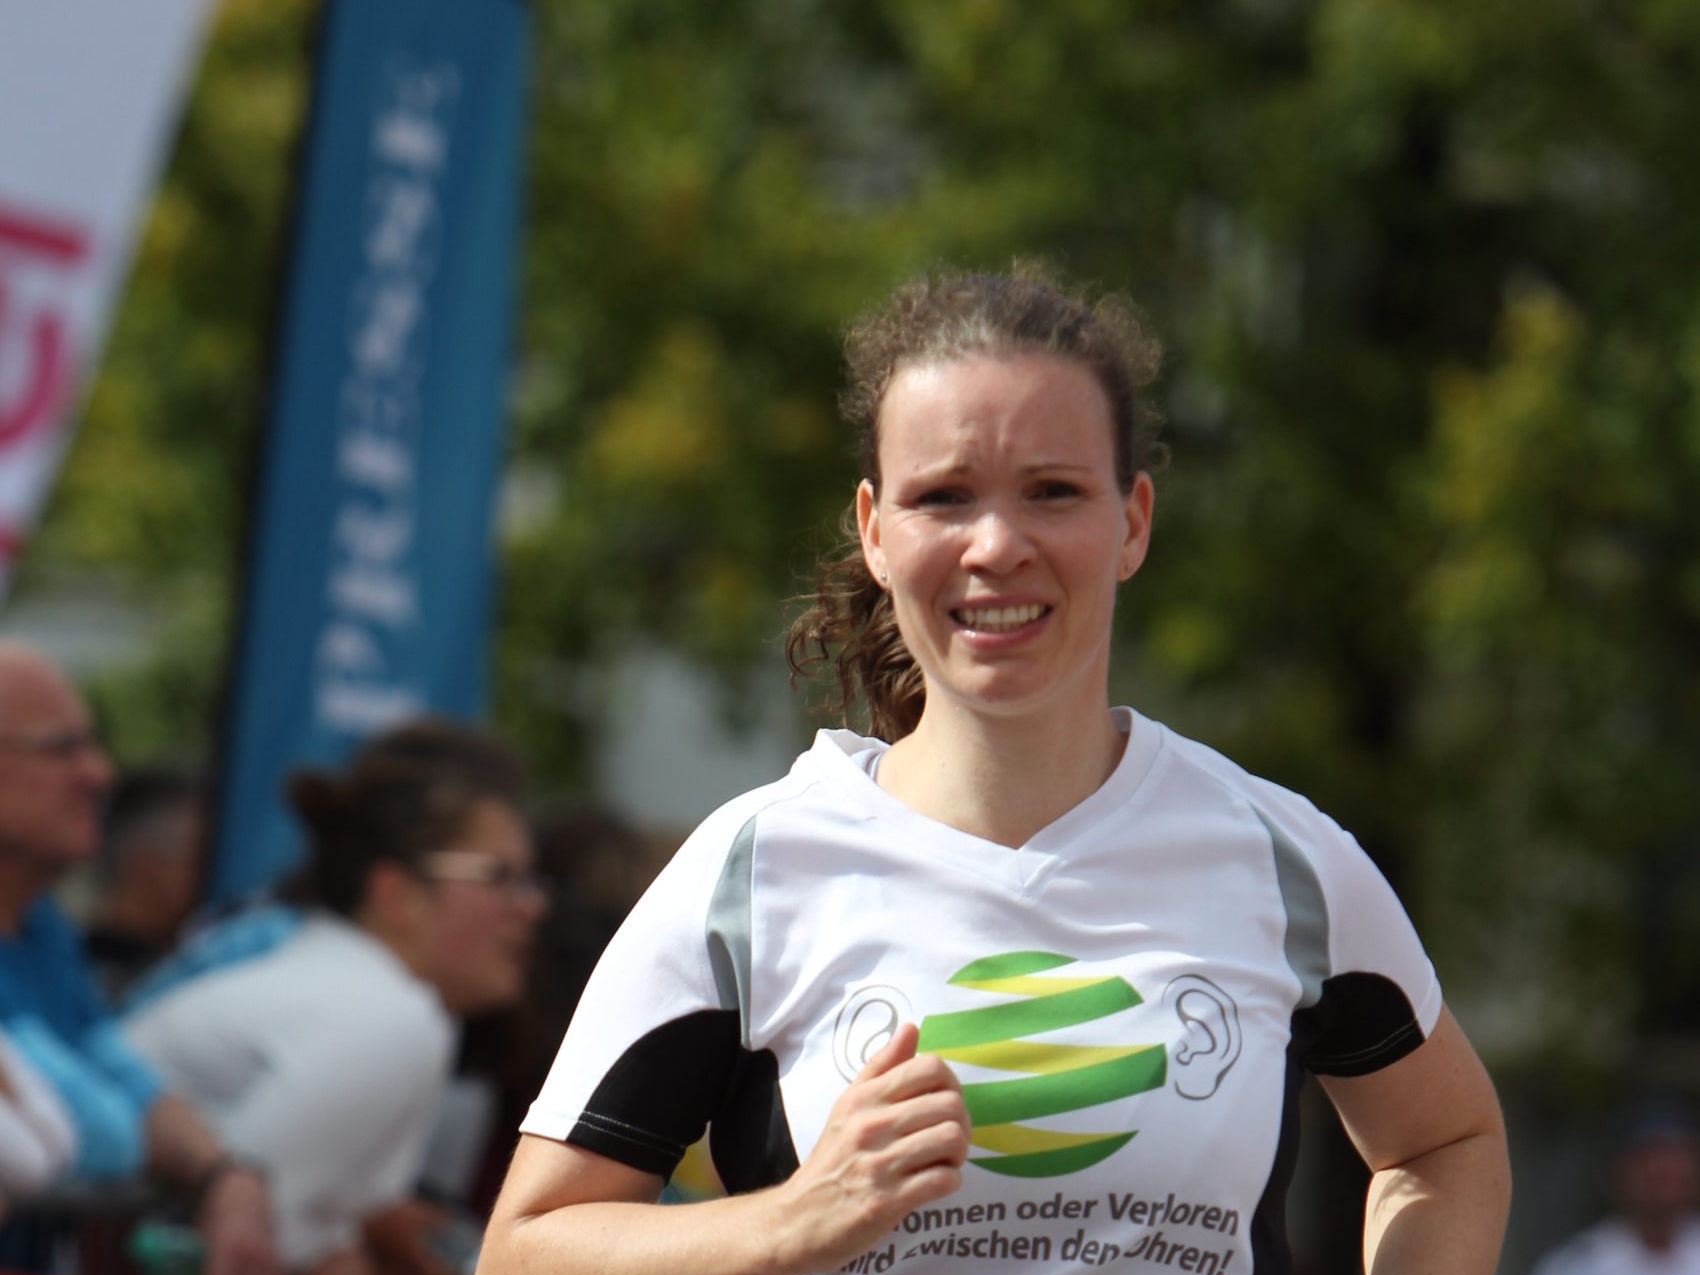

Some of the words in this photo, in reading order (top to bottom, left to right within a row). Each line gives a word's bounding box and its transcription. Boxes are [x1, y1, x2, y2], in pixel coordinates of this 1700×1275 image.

[894, 1200, 1006, 1233] onnen
[1016, 1192, 1099, 1221] oder
[1108, 1192, 1241, 1236] Verloren
